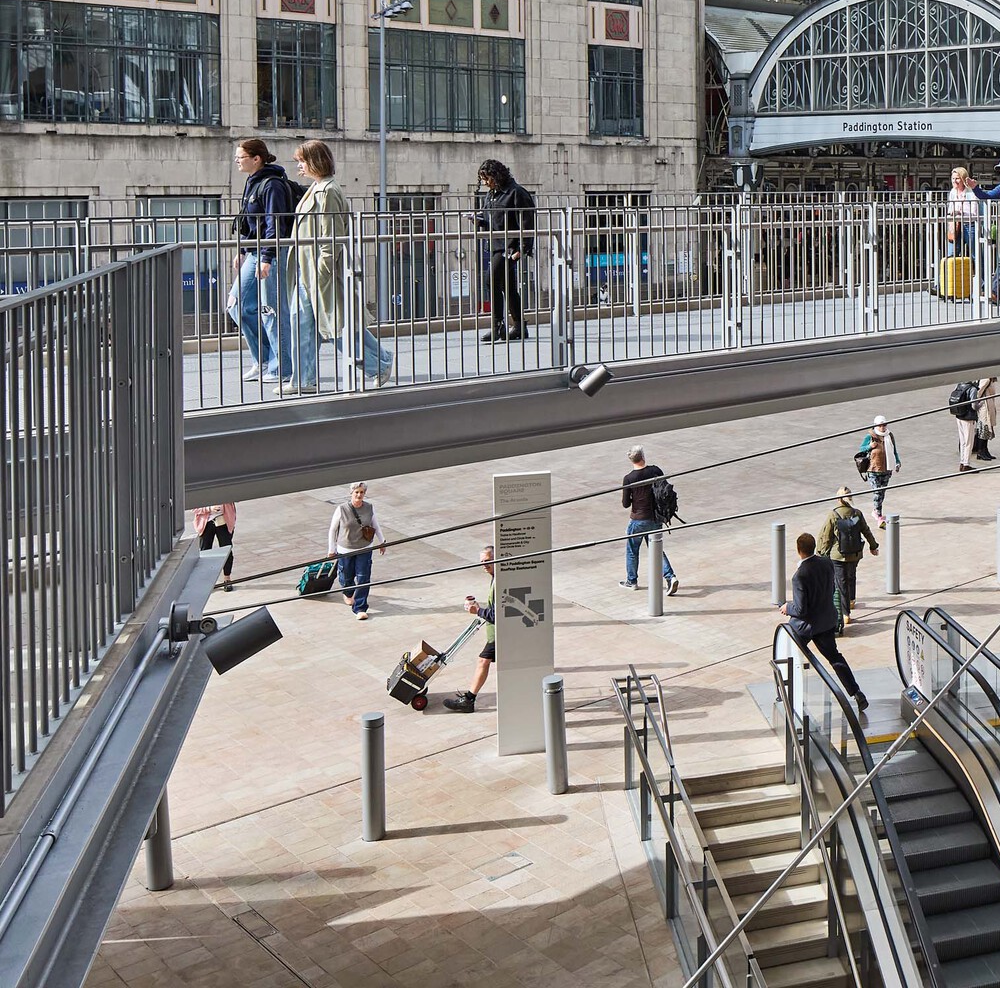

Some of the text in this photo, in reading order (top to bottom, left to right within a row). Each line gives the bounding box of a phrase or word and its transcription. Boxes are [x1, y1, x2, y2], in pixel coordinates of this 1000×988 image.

[843, 120, 933, 133] Paddington Station
[906, 620, 924, 645] SAFETY
